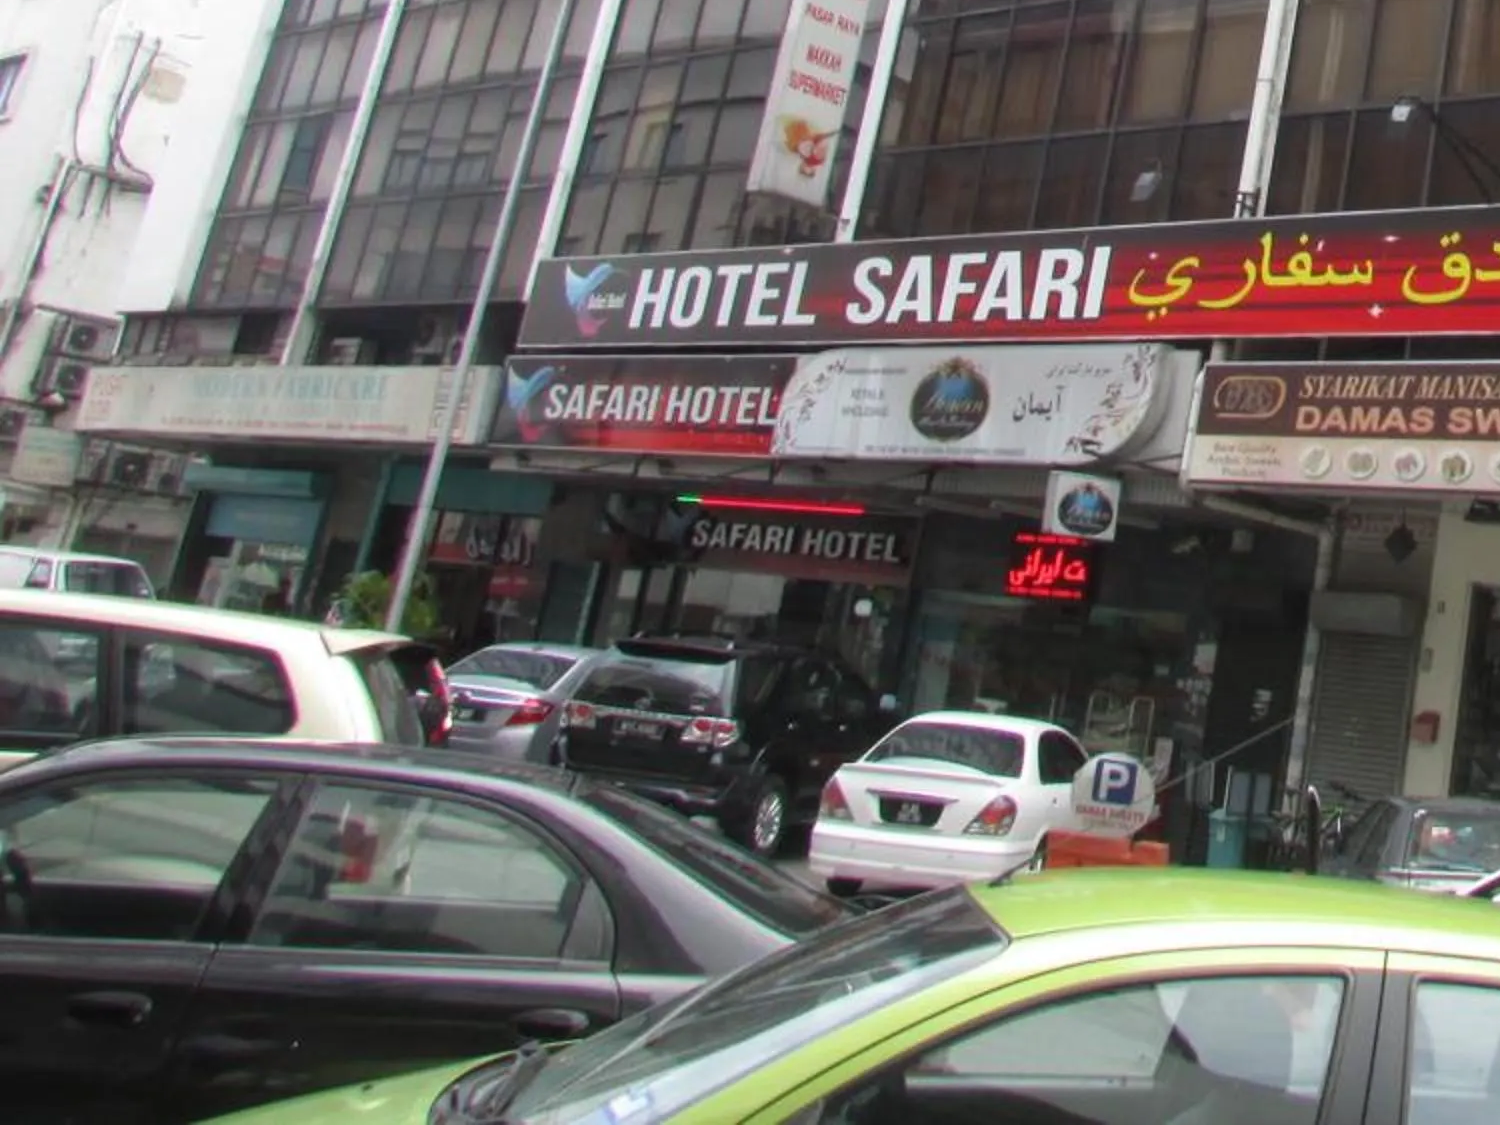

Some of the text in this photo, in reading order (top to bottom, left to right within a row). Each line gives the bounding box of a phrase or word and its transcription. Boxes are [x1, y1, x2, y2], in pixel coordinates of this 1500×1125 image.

[628, 245, 1112, 329] HOTEL SAFARI
[1128, 231, 1373, 322] سفاري
[544, 382, 780, 426] SAFARI HOTEL
[1299, 375, 1416, 400] SYARIKAT
[1295, 405, 1436, 437] DAMAS
[691, 519, 900, 562] SAFARI HOTEL
